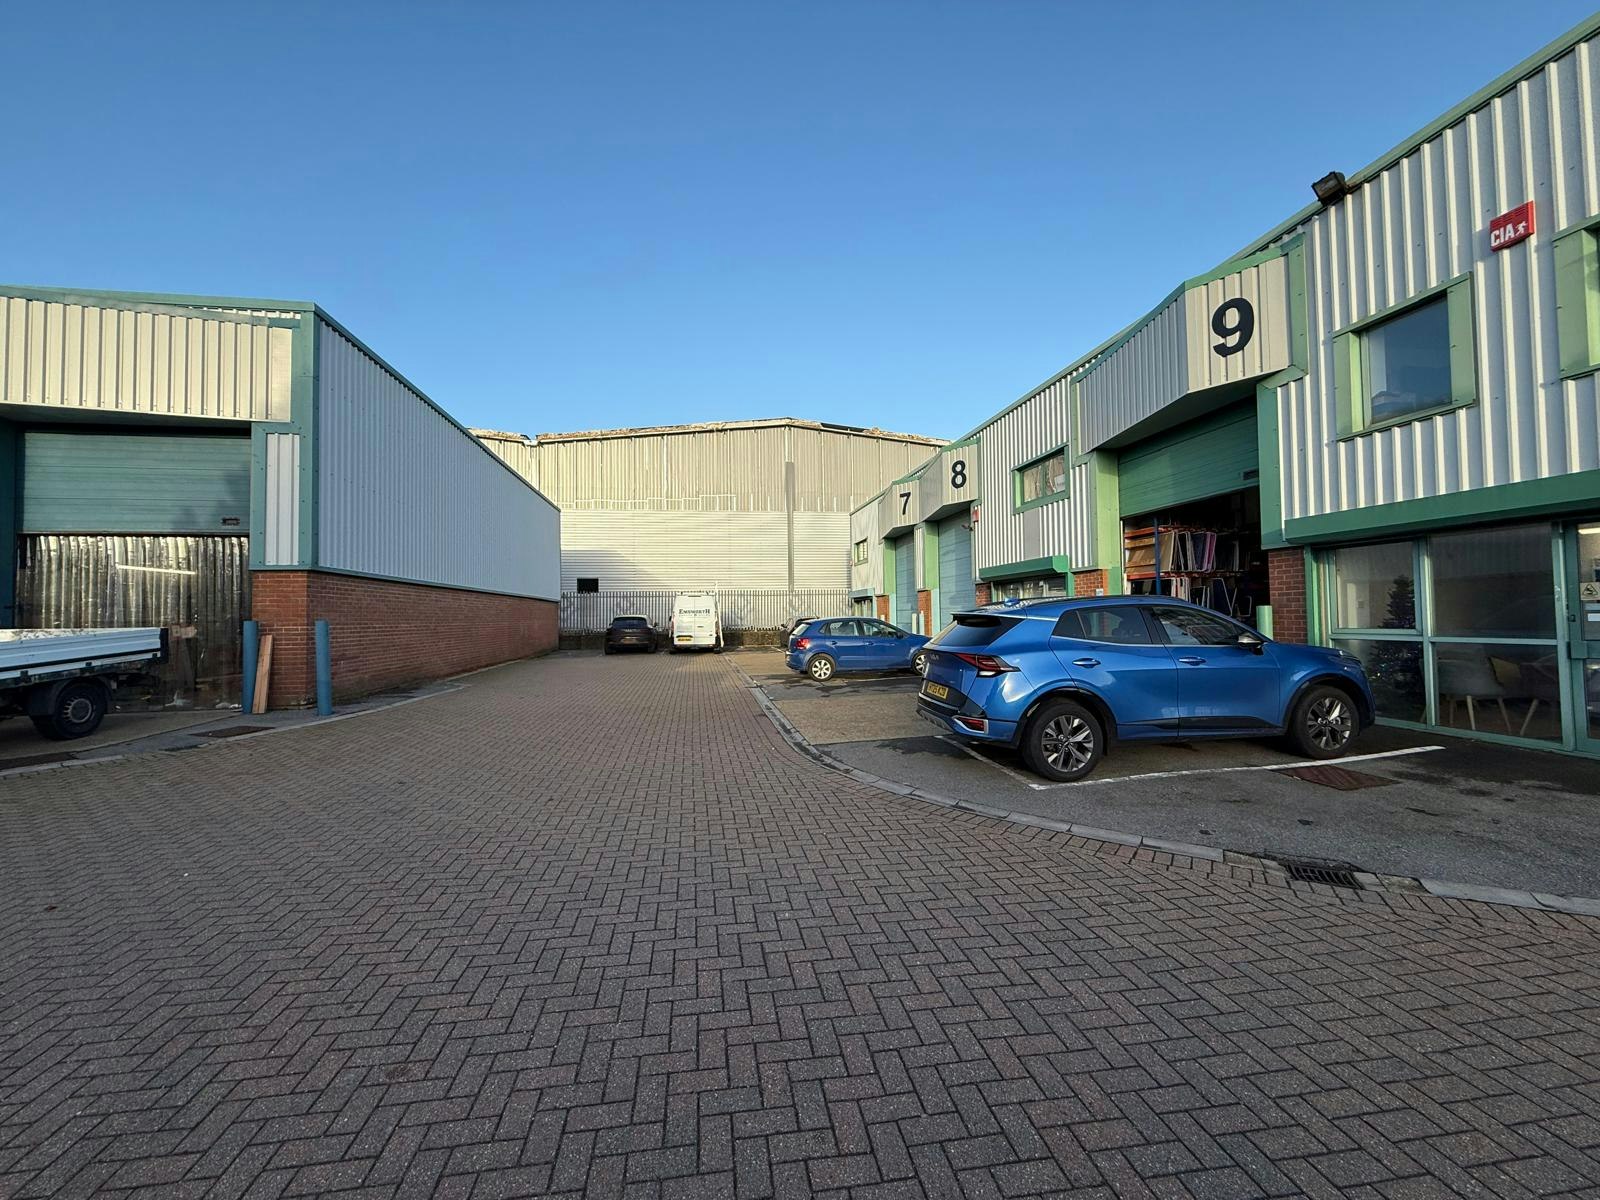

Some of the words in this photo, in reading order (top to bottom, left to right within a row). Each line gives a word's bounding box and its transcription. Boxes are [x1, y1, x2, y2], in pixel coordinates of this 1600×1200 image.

[1490, 223, 1515, 247] CIA
[1212, 297, 1255, 358] 9
[951, 460, 967, 489] 8
[899, 491, 911, 516] 7
